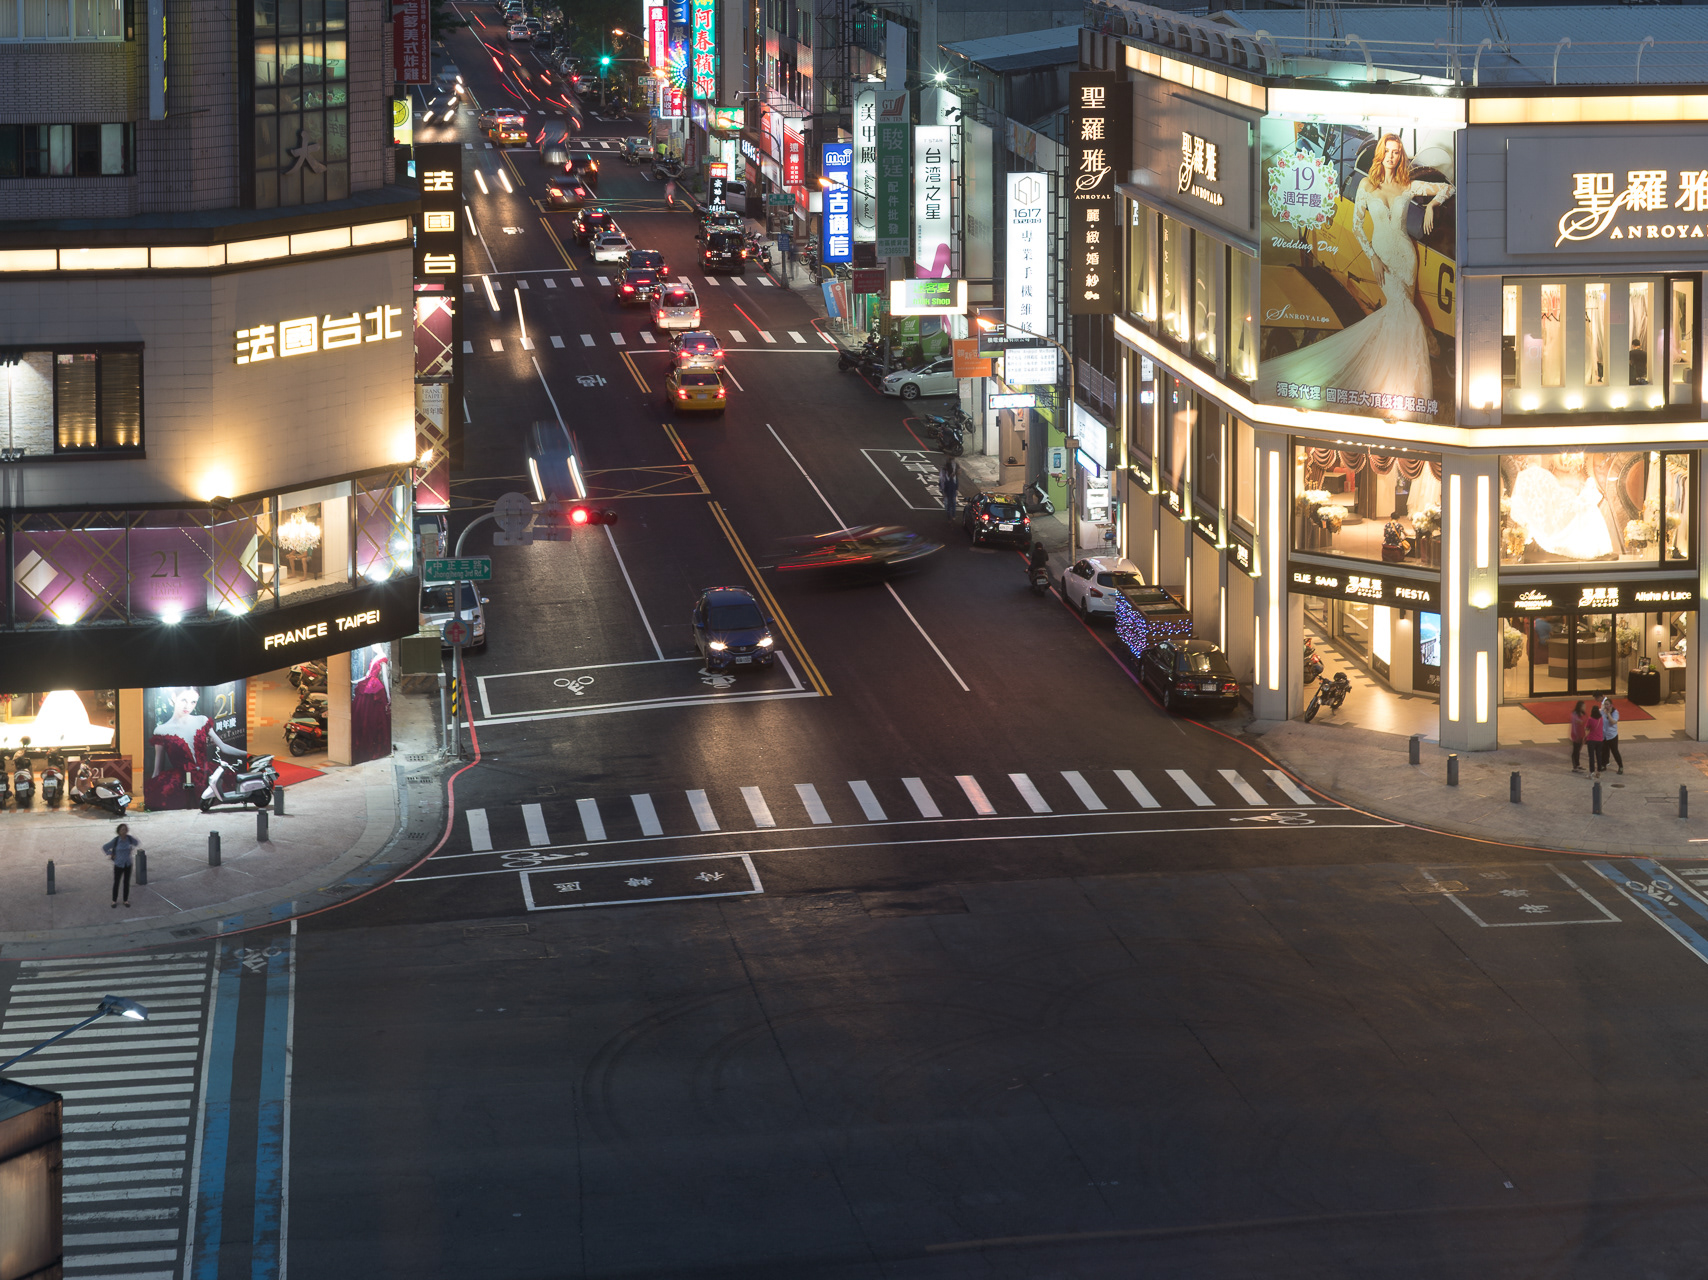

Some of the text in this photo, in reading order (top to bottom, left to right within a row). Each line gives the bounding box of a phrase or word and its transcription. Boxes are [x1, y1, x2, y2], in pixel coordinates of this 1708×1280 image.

[1080, 86, 1106, 172] 聖羅雅
[1179, 131, 1217, 182] 聖羅雅
[1292, 166, 1315, 191] 19
[1572, 170, 1708, 212] 聖羅雅
[1283, 190, 1322, 209] 週年慶
[1013, 208, 1042, 218] 1617
[1554, 184, 1708, 248] SANROYA
[1271, 236, 1339, 255] Wedding Day
[233, 304, 403, 365] 法國台北
[150, 550, 182, 578] 21
[433, 560, 483, 571] 中正三路
[1293, 573, 1338, 587] ELIE SAAB
[1395, 587, 1431, 601] FIESTA
[1671, 590, 1692, 600] Lace
[264, 609, 381, 650] FRANCE TAIPEI
[214, 690, 237, 720] 21
[92, 767, 105, 779] 21
